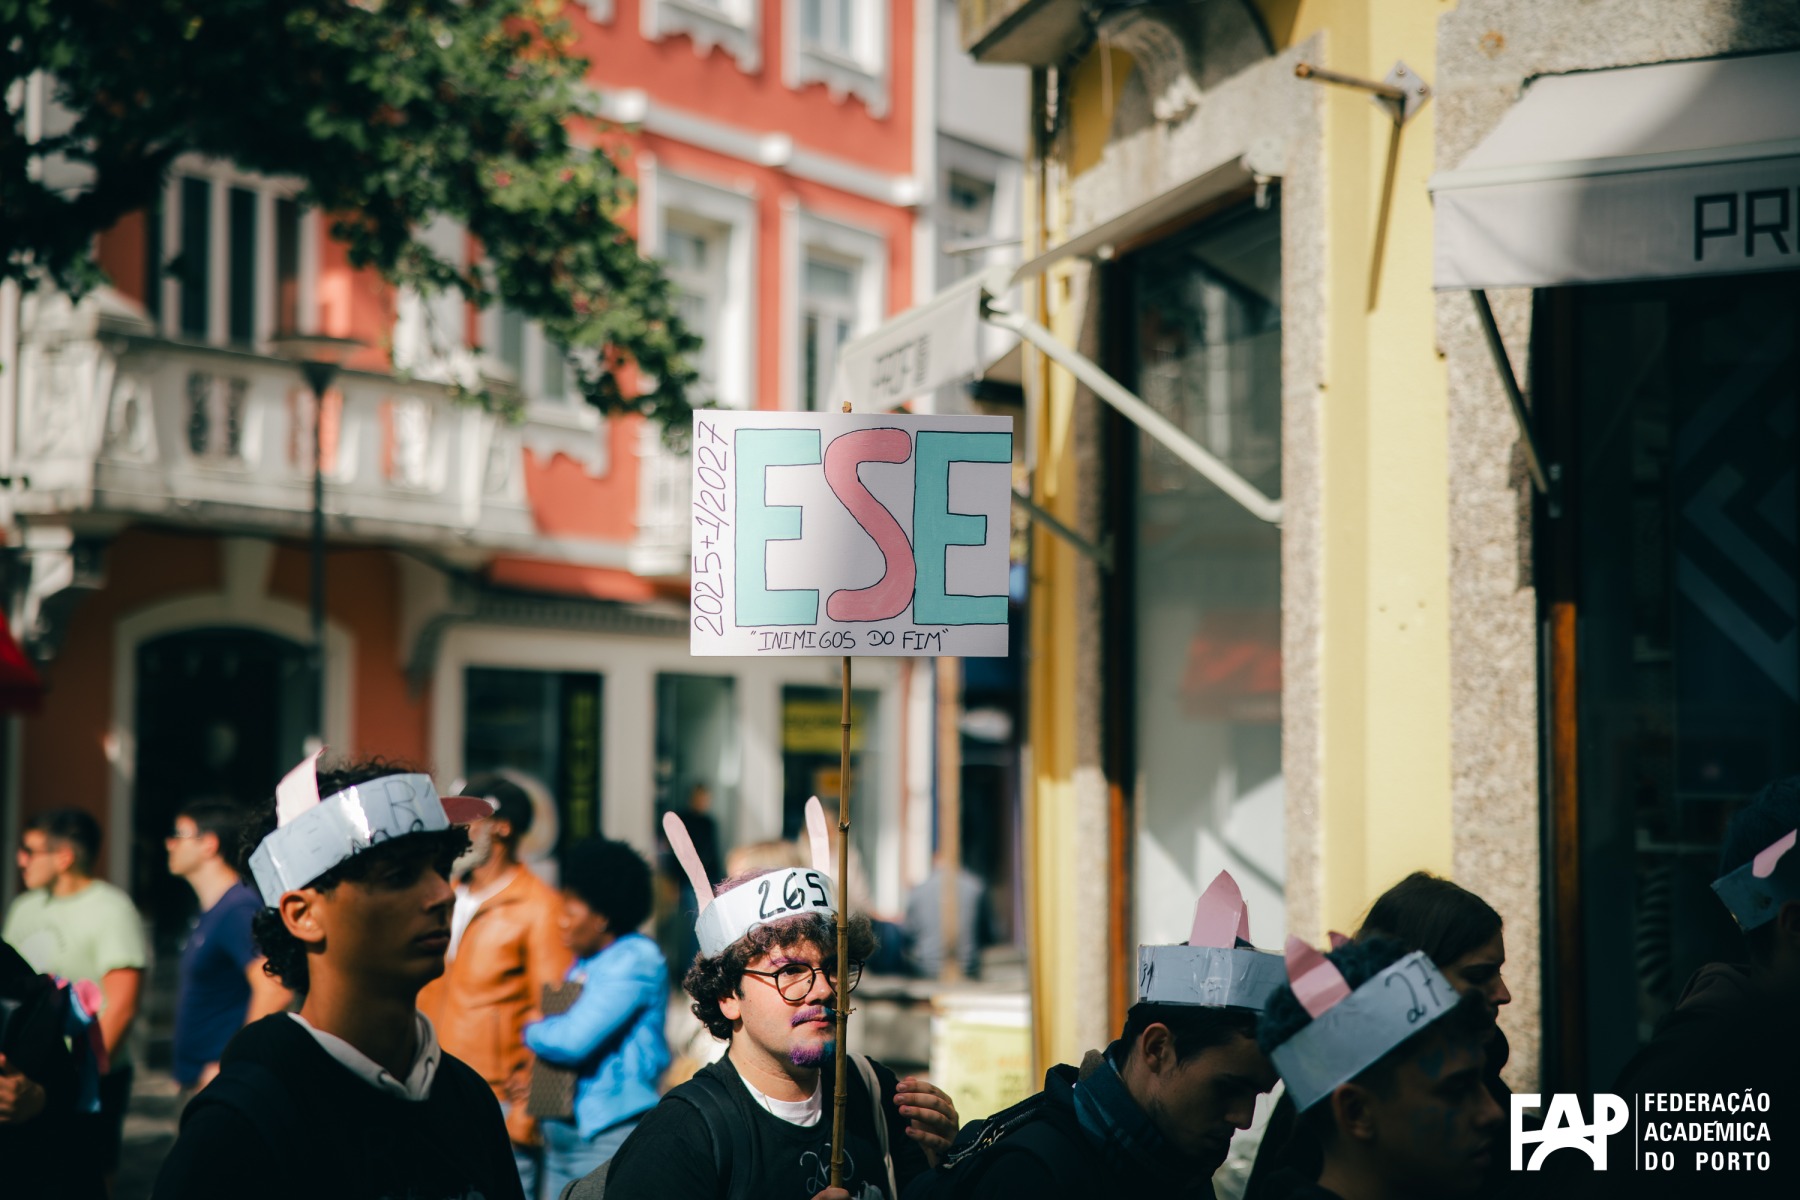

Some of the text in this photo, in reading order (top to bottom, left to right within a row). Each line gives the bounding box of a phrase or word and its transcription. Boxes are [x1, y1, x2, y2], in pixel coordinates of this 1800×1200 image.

[692, 420, 730, 637] 2025+1/2027
[735, 426, 1013, 627] ESE
[866, 630, 895, 646] DO
[757, 871, 829, 920] 265
